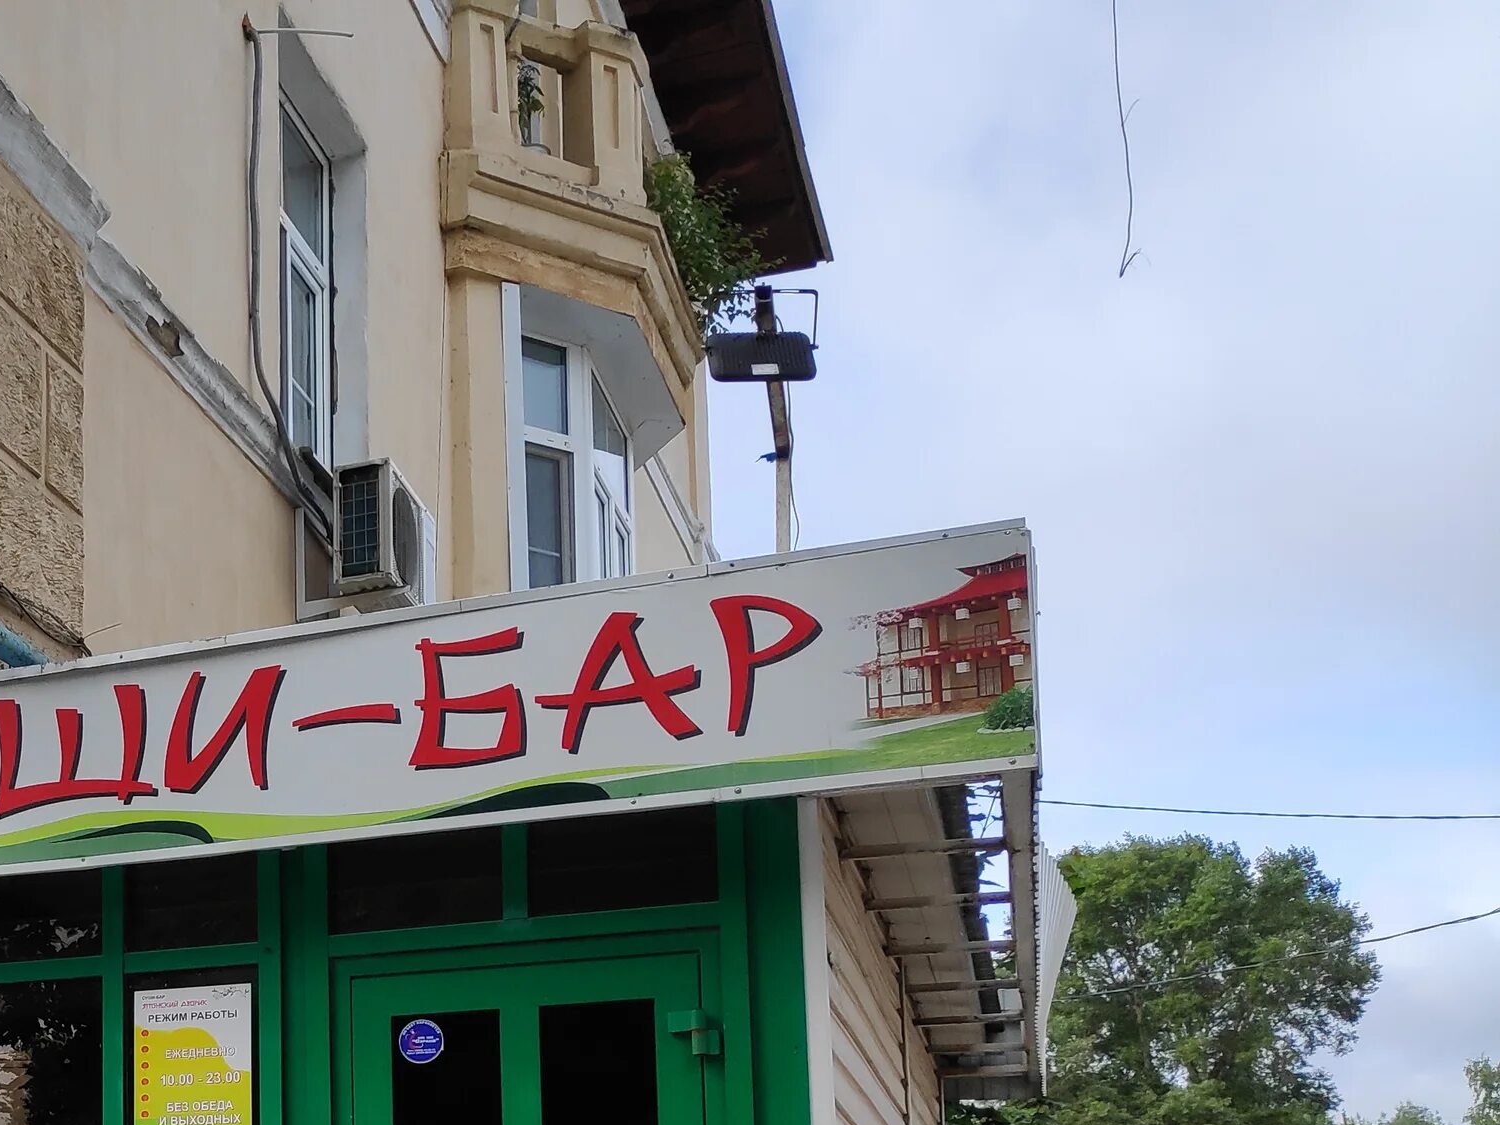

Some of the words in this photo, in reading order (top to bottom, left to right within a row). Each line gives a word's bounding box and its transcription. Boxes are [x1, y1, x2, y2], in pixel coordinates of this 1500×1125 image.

[148, 1013, 187, 1023] РЕЖИМ
[191, 1009, 238, 1020] РАБОТЫ
[165, 1046, 236, 1059] ЕЖЕДНЕВНО
[160, 1073, 194, 1086] 10.00
[206, 1071, 241, 1084] 23.00
[166, 1102, 189, 1112] БЕЗ
[192, 1100, 234, 1112] ОБЕДА
[159, 1116, 167, 1125] И
[170, 1113, 242, 1125] ВЫХОДНЫХ
